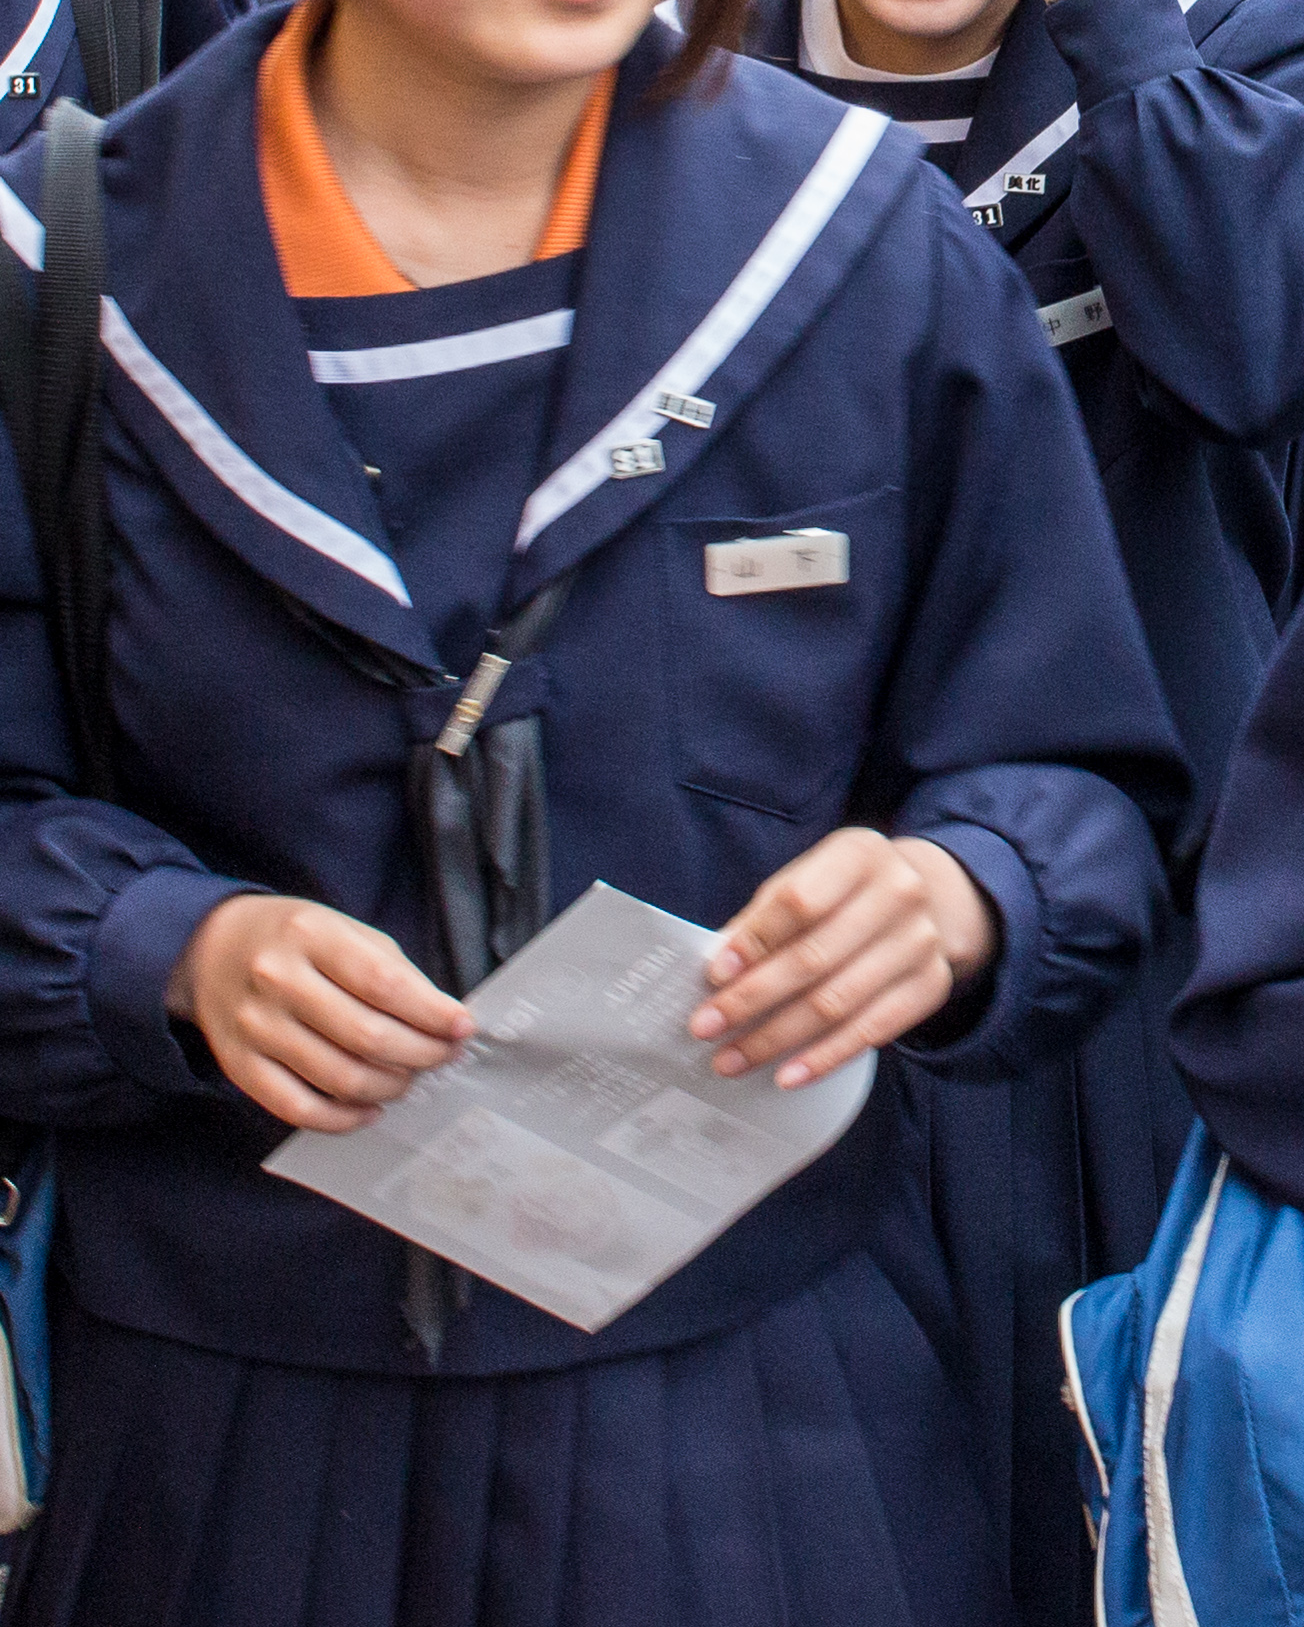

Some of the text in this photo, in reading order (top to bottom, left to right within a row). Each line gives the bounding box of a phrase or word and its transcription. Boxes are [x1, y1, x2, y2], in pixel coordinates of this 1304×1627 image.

[13, 77, 37, 94] 31
[1008, 175, 1041, 191] 美化
[972, 208, 997, 226] 31
